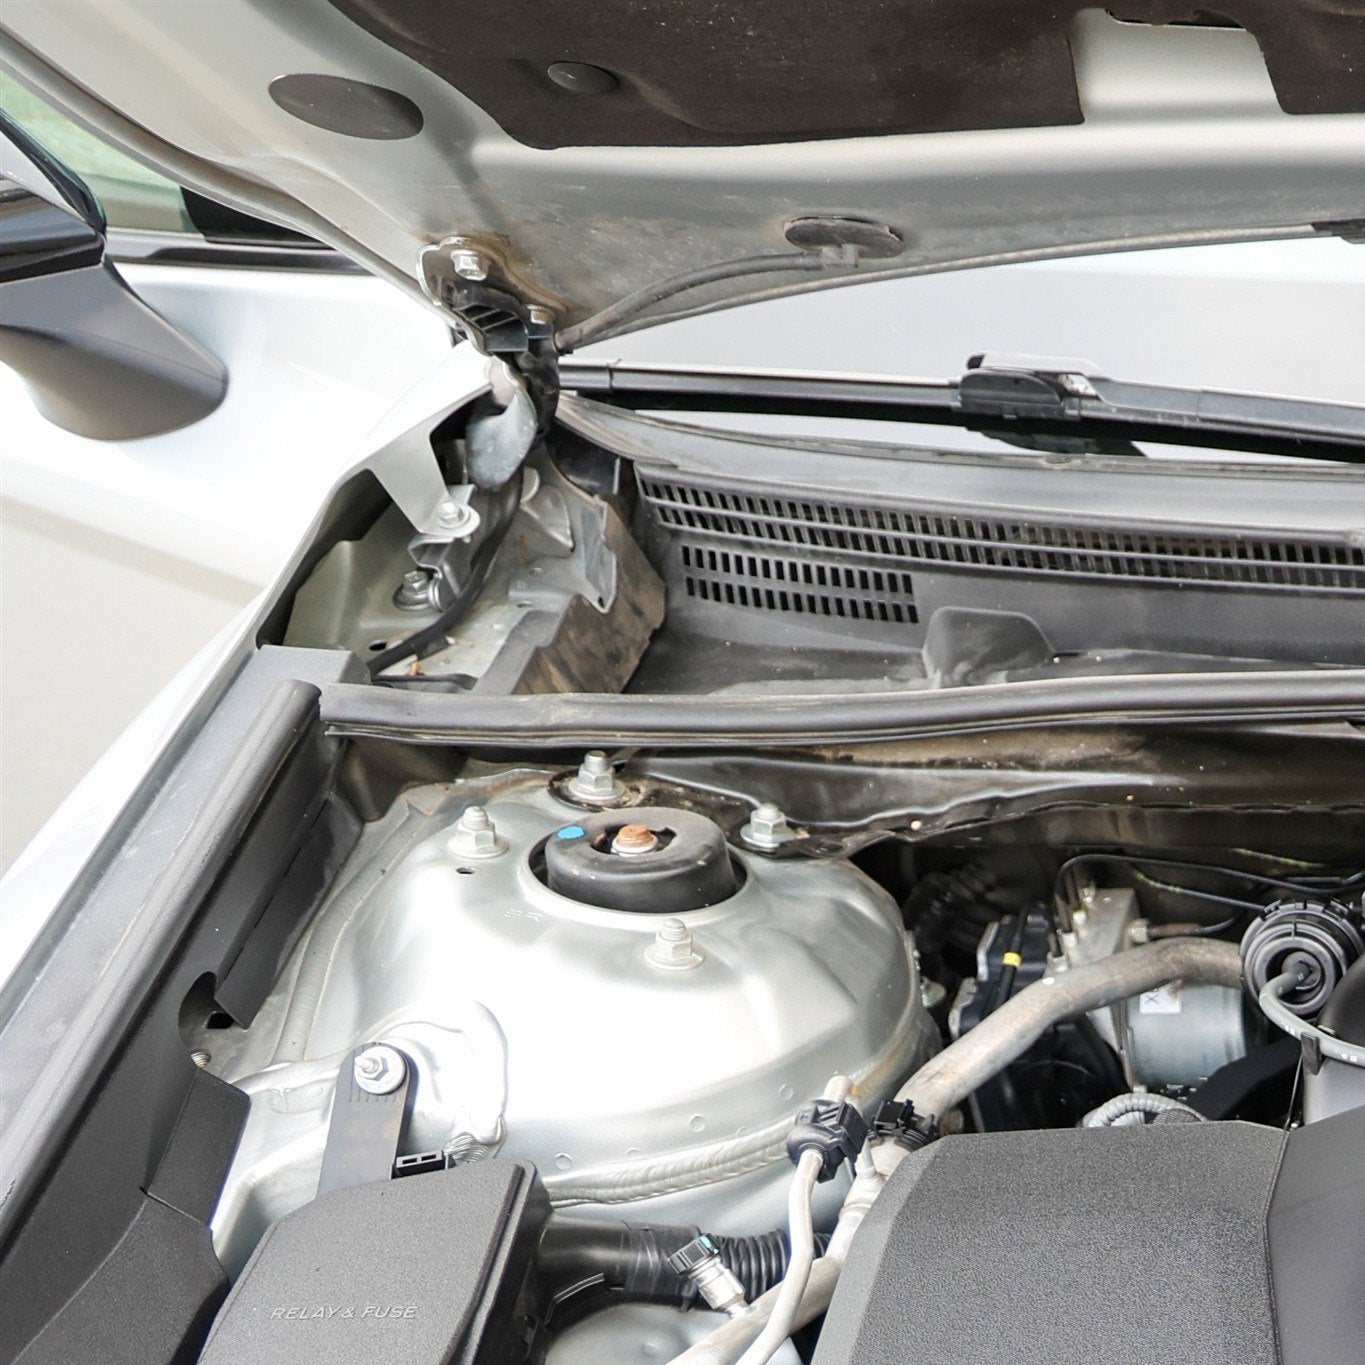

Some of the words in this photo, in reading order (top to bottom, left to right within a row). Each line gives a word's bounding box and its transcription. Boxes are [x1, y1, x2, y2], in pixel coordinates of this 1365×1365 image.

[270, 1306, 341, 1320] RELAY
[341, 1306, 356, 1319] &
[361, 1305, 419, 1319] FUSE
